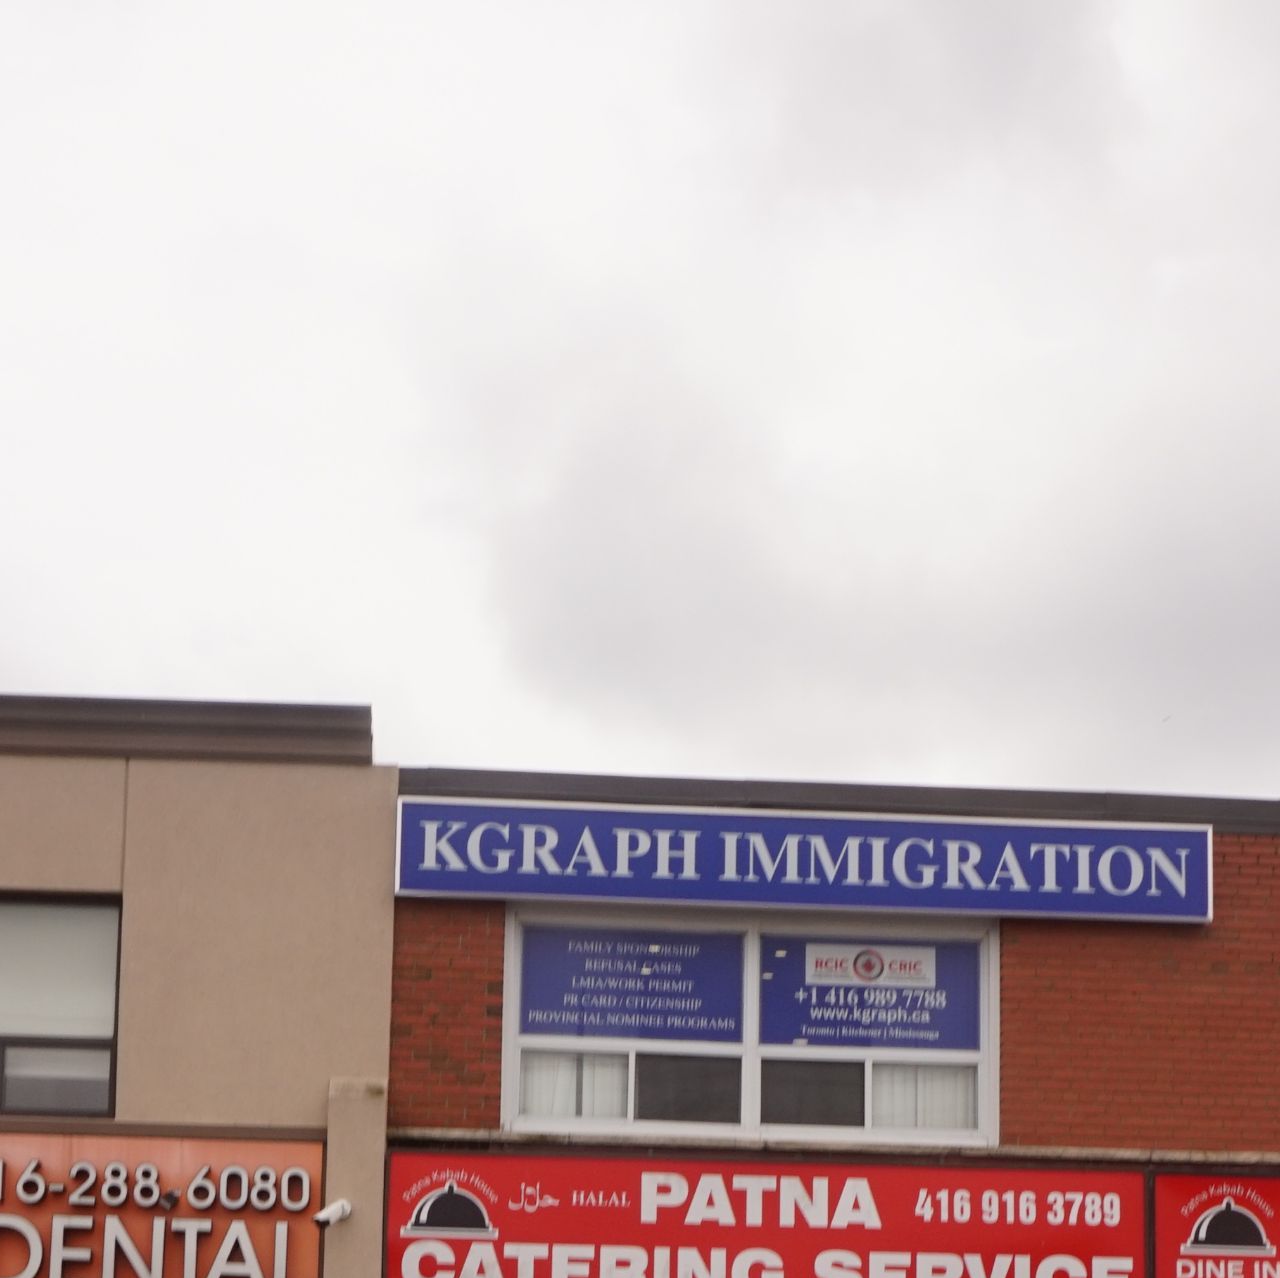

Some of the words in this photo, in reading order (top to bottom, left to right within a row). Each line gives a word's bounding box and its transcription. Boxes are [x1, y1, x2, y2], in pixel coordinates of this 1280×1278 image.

[418, 820, 702, 881] KGRAPH
[718, 830, 1191, 899] IMMIGRATION
[568, 941, 613, 954] FAMILY
[616, 942, 700, 958] SPONORSHIP
[585, 959, 638, 973] REFUSAL
[572, 976, 645, 991] LMIA/WORK
[648, 979, 695, 993] PERMIT
[563, 994, 578, 1007] PR
[581, 994, 617, 1008] CARD
[626, 996, 703, 1011] CITIZENSHIP
[794, 987, 817, 1006] +1
[824, 987, 859, 1006] 416
[864, 989, 897, 1008] 989
[902, 989, 947, 1010] 7788
[528, 1010, 604, 1026] PROVINCIAL
[607, 1013, 664, 1028] NOMINEE
[667, 1016, 736, 1031] PROGRAMS
[810, 1006, 931, 1025] www.kgraph.ca
[572, 1190, 630, 1208] HALAL
[639, 1172, 883, 1229] PATNA
[914, 1188, 971, 1224] 416
[981, 1189, 1037, 1225] 916
[1046, 1190, 1121, 1227] 3789
